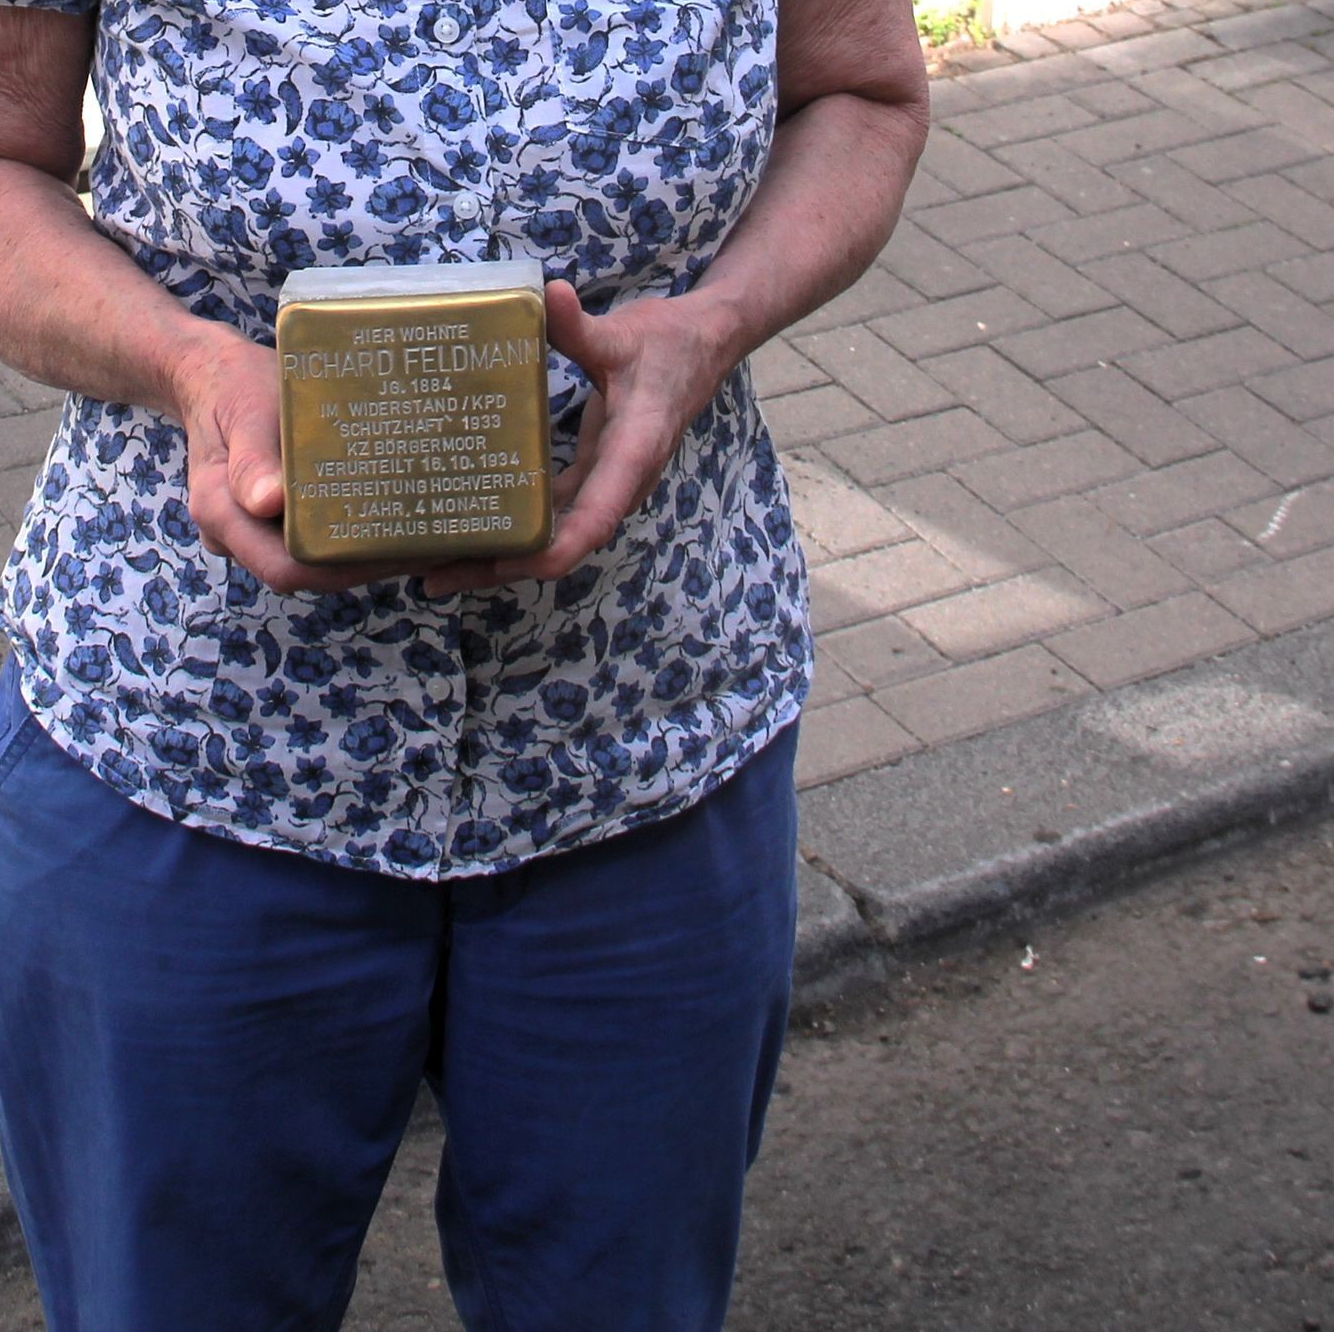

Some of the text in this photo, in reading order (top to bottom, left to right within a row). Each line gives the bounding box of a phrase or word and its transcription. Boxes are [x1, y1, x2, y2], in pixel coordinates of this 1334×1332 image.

[353, 324, 469, 345] HIER WOHNTE
[283, 337, 540, 380] RICHARD FELDMANN
[378, 377, 453, 395] JG. 1884
[321, 403, 338, 418] IM
[462, 414, 501, 430] 1933
[347, 435, 486, 456] KZ BÖRGERMOOR
[315, 458, 414, 477] VERURTEILT
[344, 495, 499, 518] 1 JAHR, 4 MONATE
[329, 515, 512, 539] ZUCHTHAUS SIEGBURG
